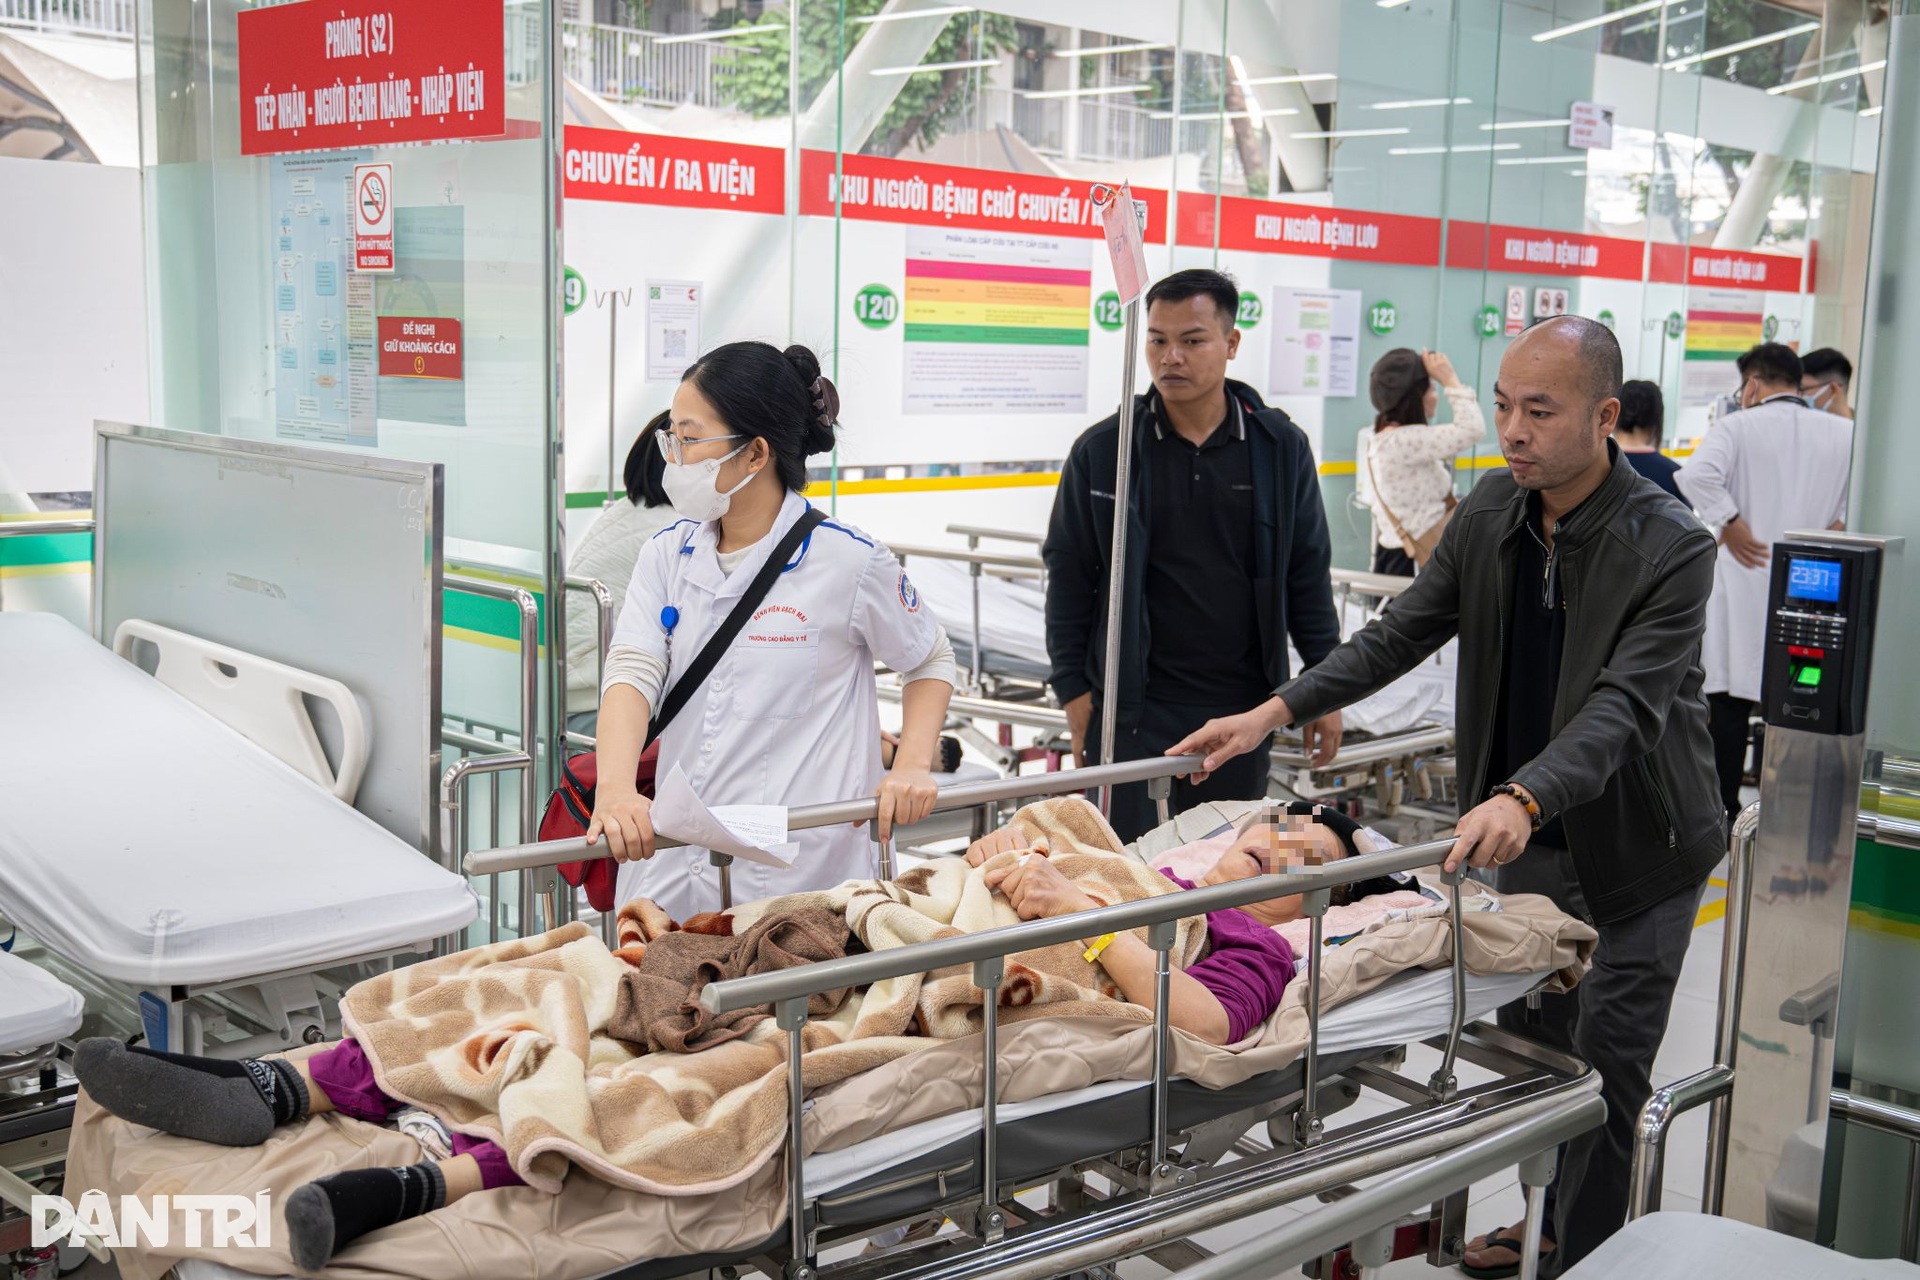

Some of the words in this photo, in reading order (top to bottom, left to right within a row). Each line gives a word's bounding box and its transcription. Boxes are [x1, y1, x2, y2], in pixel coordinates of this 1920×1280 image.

[326, 10, 362, 59] PHÒNG
[255, 82, 276, 131] TIẾP
[278, 84, 306, 136] NHẬN
[314, 77, 347, 126] NGƯỜI
[348, 76, 378, 131] BỆNH
[380, 72, 411, 128] NẶNG
[421, 65, 453, 123] NHẬP
[456, 62, 484, 120] VIỆN
[566, 142, 655, 188] CHUYỂN
[659, 157, 670, 189] /
[674, 158, 703, 192] RA
[707, 158, 755, 202] VIỆN
[828, 173, 869, 206] KHU
[873, 175, 928, 211] NGƯỜI
[932, 179, 978, 219] BỆNH
[981, 185, 1016, 219] CHỜ
[1018, 187, 1079, 225] CHUYỂN
[1255, 214, 1282, 240] KHU
[1283, 214, 1321, 244] NGƯỜI
[1322, 217, 1354, 251] BỆNH
[1355, 223, 1379, 249] LƯU
[1555, 239, 1579, 269] BỆNH
[857, 294, 896, 321] 120
[1373, 307, 1395, 328] 123
[384, 338, 398, 352] GIỮ
[433, 340, 456, 355] CÁCH
[415, 323, 435, 338] NGHỊ
